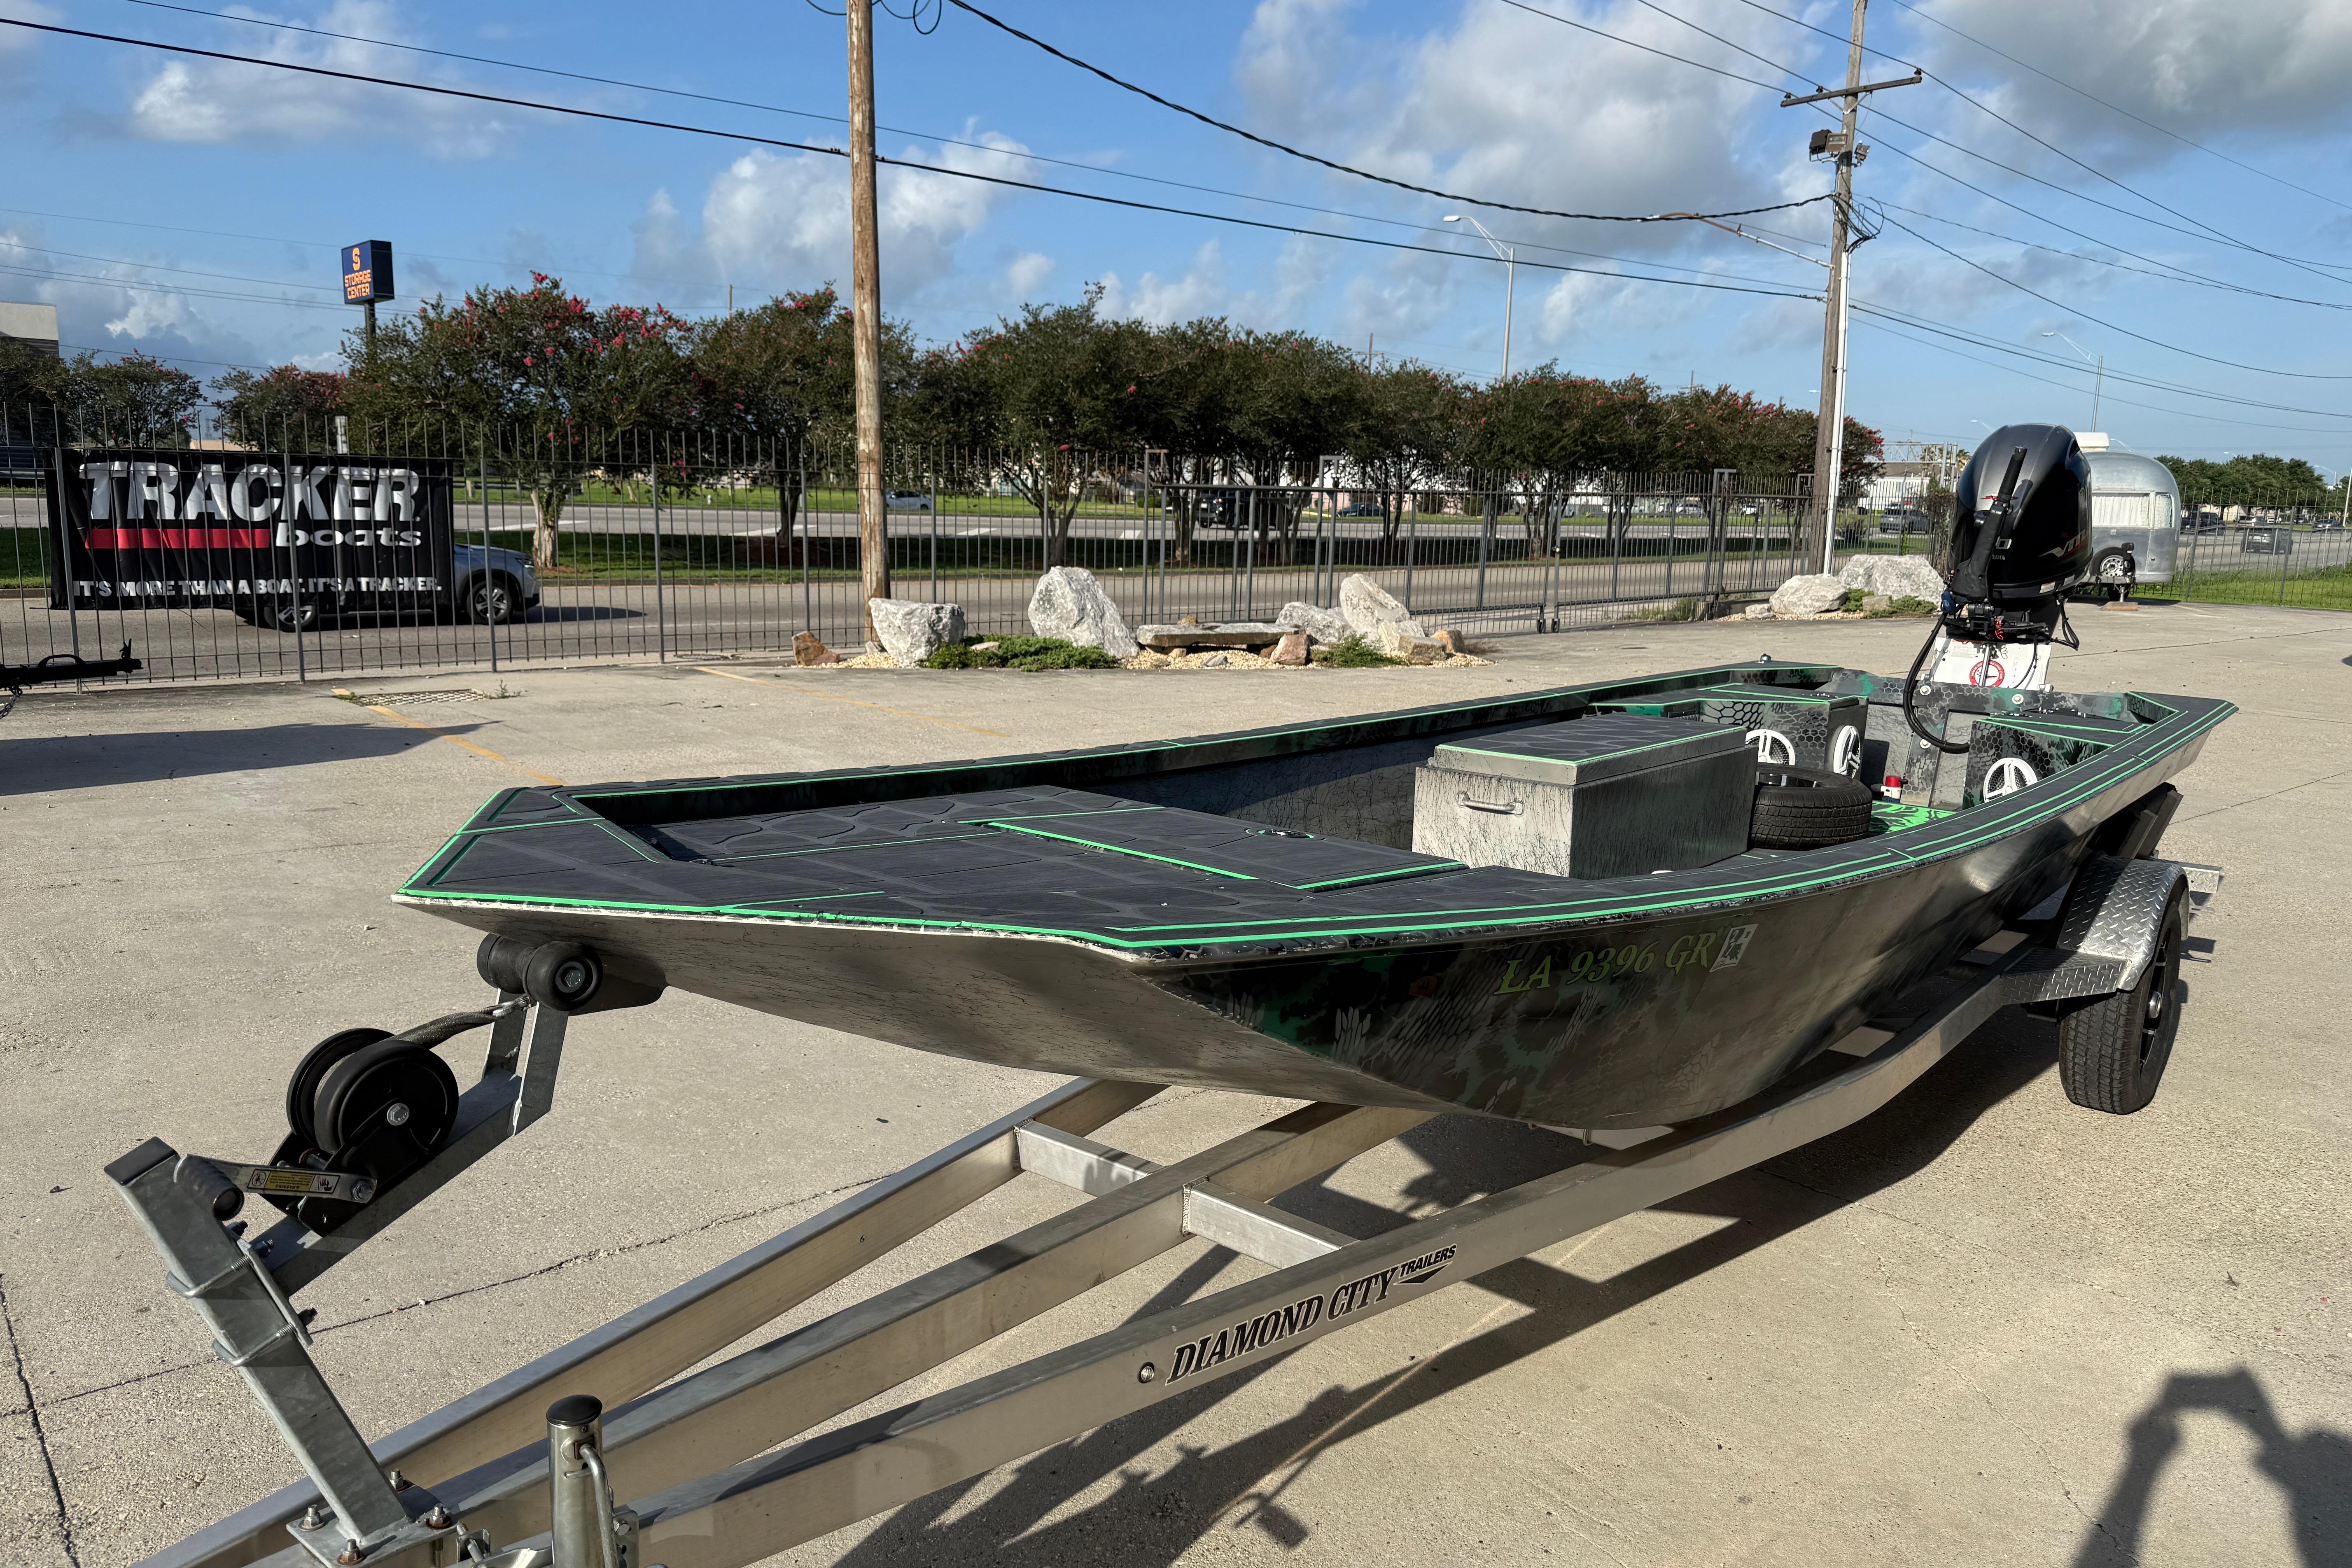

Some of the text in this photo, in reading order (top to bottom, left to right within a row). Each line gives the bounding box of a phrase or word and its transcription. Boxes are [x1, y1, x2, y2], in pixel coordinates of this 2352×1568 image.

[345, 269, 371, 287] STORAGE
[347, 283, 370, 300] CENTER
[79, 461, 420, 522] TRACKER
[275, 522, 422, 547] boats
[73, 580, 111, 597] IT'S
[118, 581, 175, 596] MORE
[178, 580, 233, 595] THAN
[236, 580, 251, 595] A
[344, 578, 355, 592] A
[1493, 931, 1717, 996] LA 9396 GR
[1164, 1244, 1457, 1386] DIAMOND CITY TRAILERS
